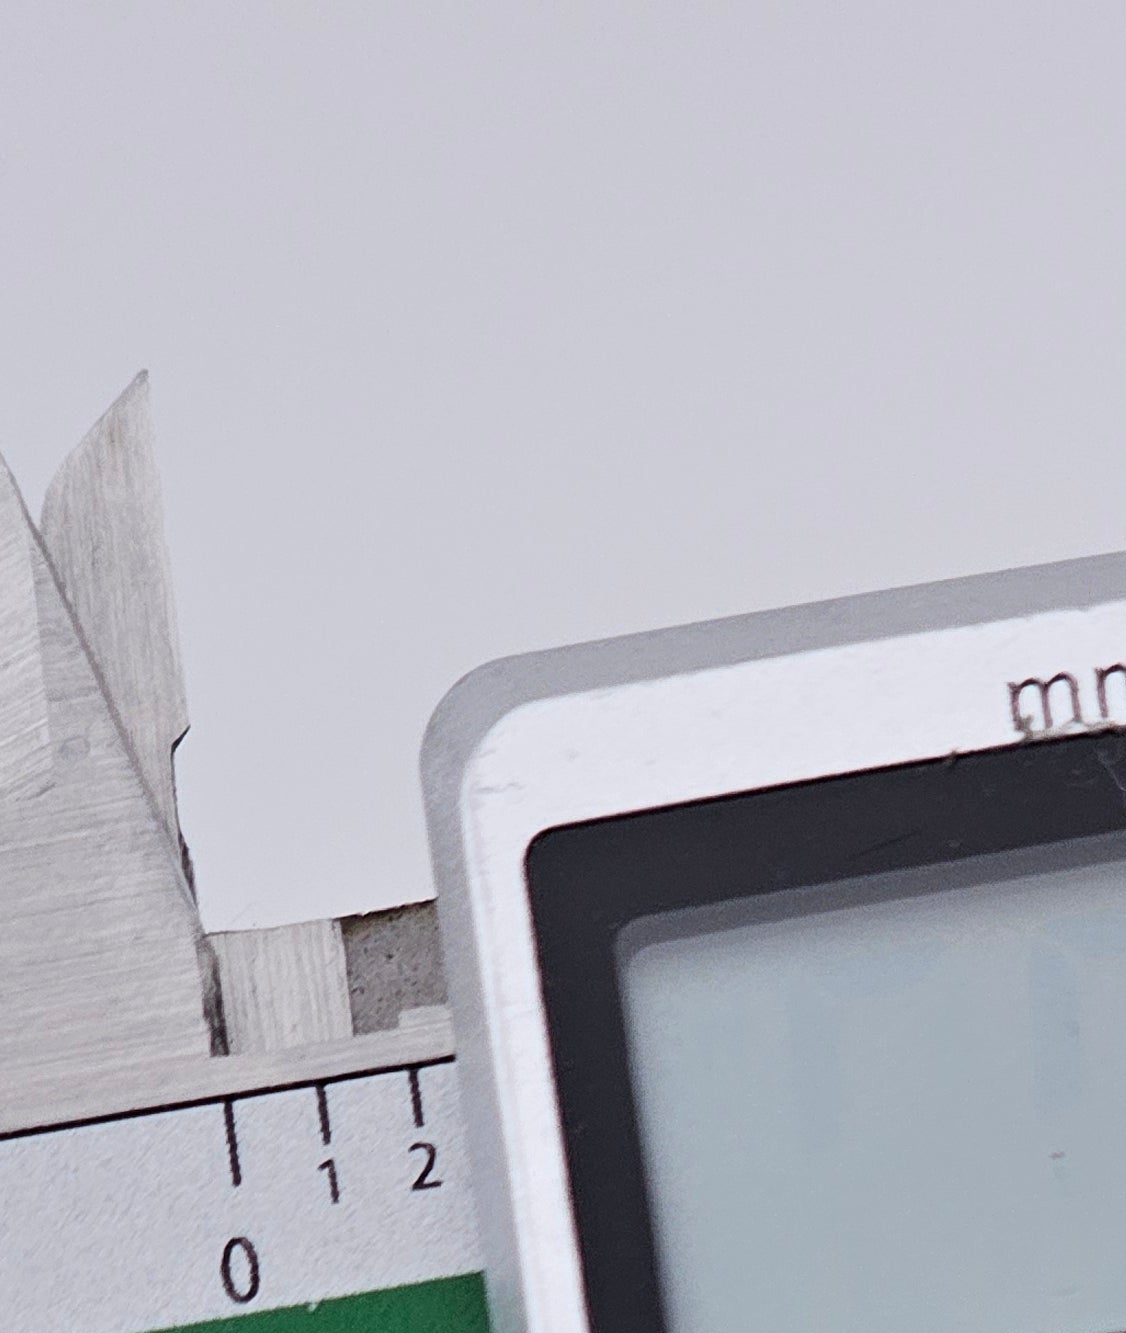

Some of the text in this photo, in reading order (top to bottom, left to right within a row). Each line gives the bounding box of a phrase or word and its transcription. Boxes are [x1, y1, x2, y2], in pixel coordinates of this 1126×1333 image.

[317, 1157, 340, 1204] 1
[408, 1142, 442, 1191] 2
[220, 1236, 260, 1303] 0
